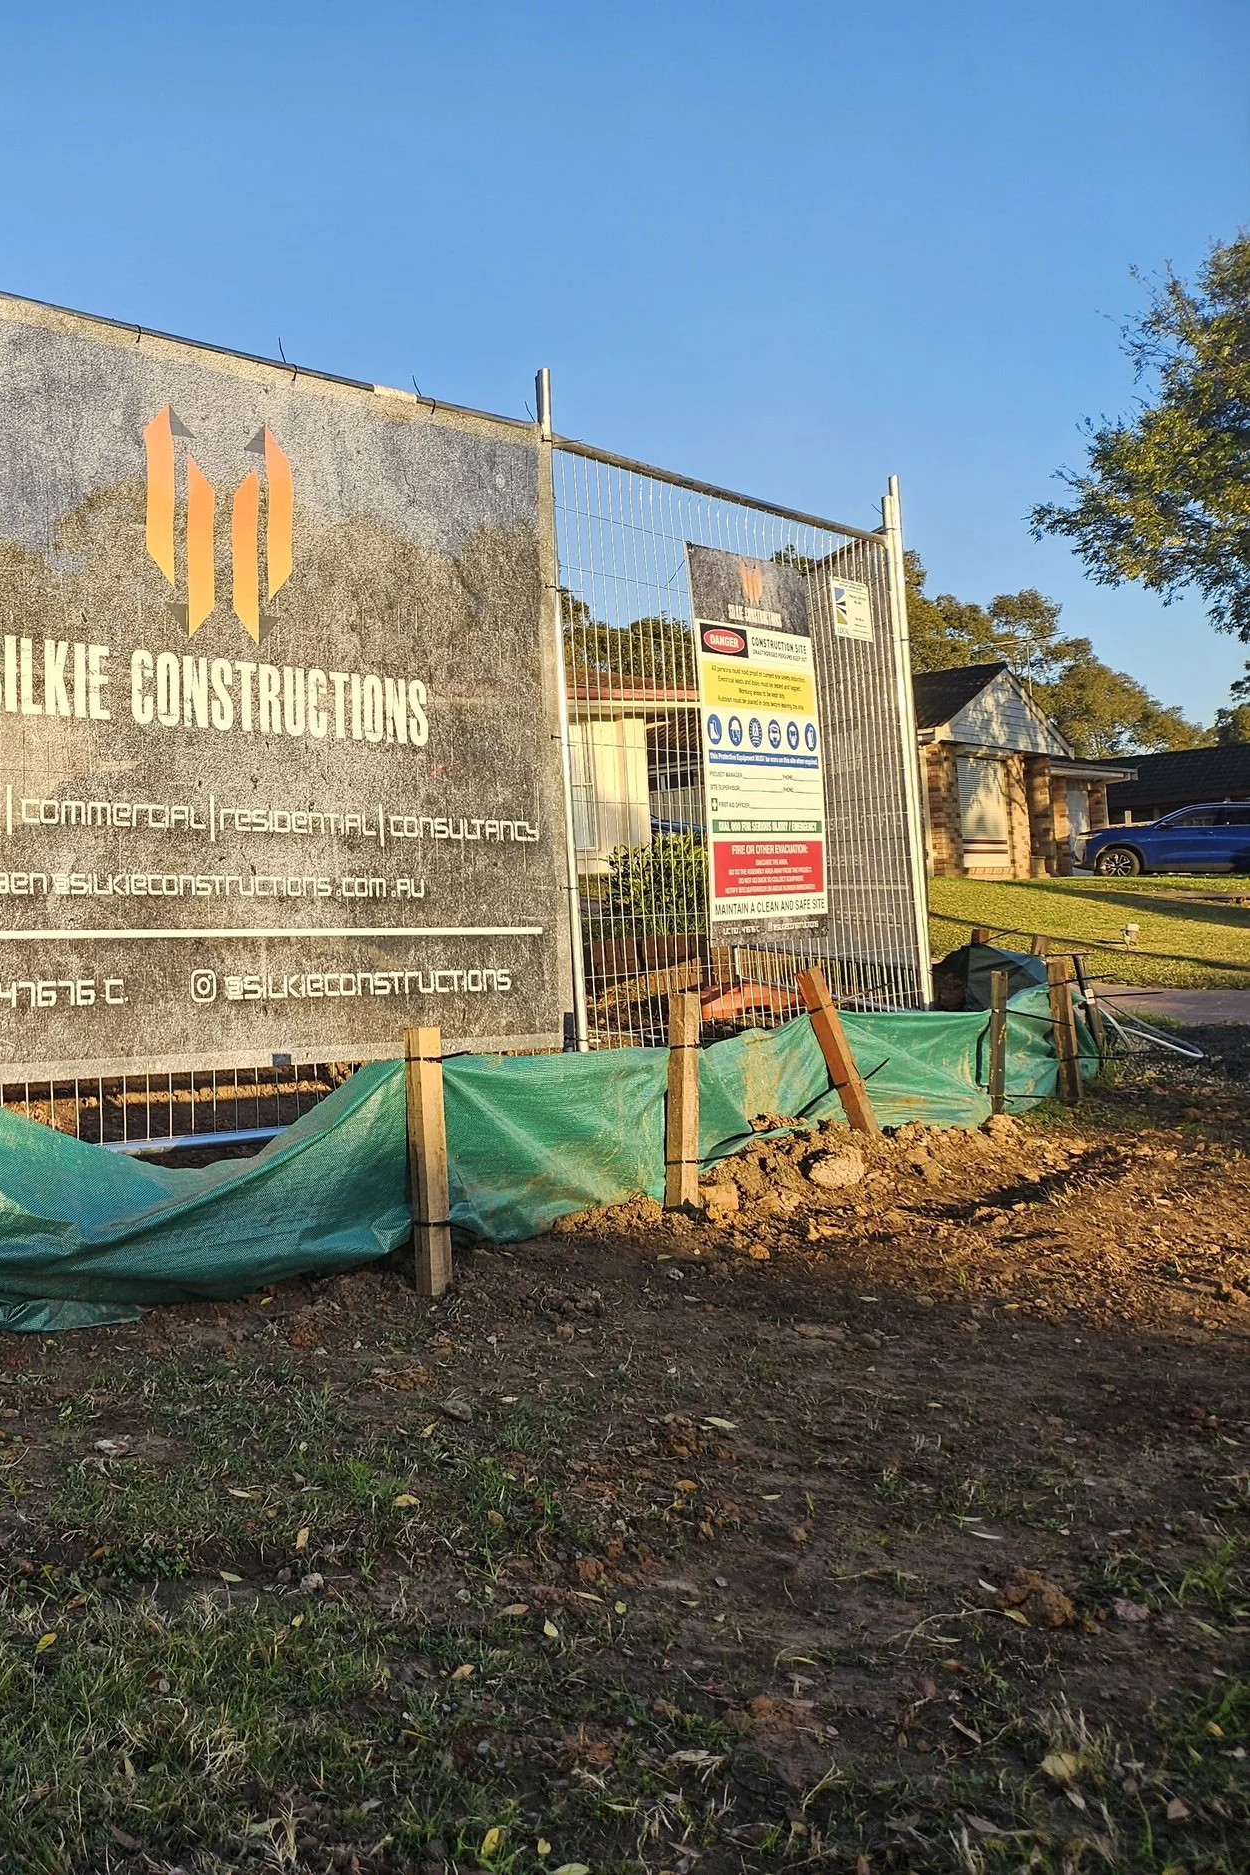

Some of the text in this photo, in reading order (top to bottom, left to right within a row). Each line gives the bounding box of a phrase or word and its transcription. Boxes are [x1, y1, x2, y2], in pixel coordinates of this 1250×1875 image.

[709, 634, 740, 649] DANGER
[751, 636, 807, 655] CONSTRUCTION SITE
[717, 666, 732, 674] persons
[718, 674, 734, 683] Electrical
[131, 648, 429, 747] CONSTRUCTIONS
[719, 752, 736, 760] Protective
[736, 753, 754, 763] Equipment
[718, 821, 730, 832] DIAL
[742, 822, 751, 832] FOR
[752, 822, 771, 832] SERIOUS
[792, 822, 817, 832] EMERGENCY
[731, 844, 745, 855] FIRE
[746, 844, 755, 855] OR
[756, 844, 774, 854] OTHER
[715, 898, 825, 916] MAINTAIN A CLEAN AND SAFE SITE
